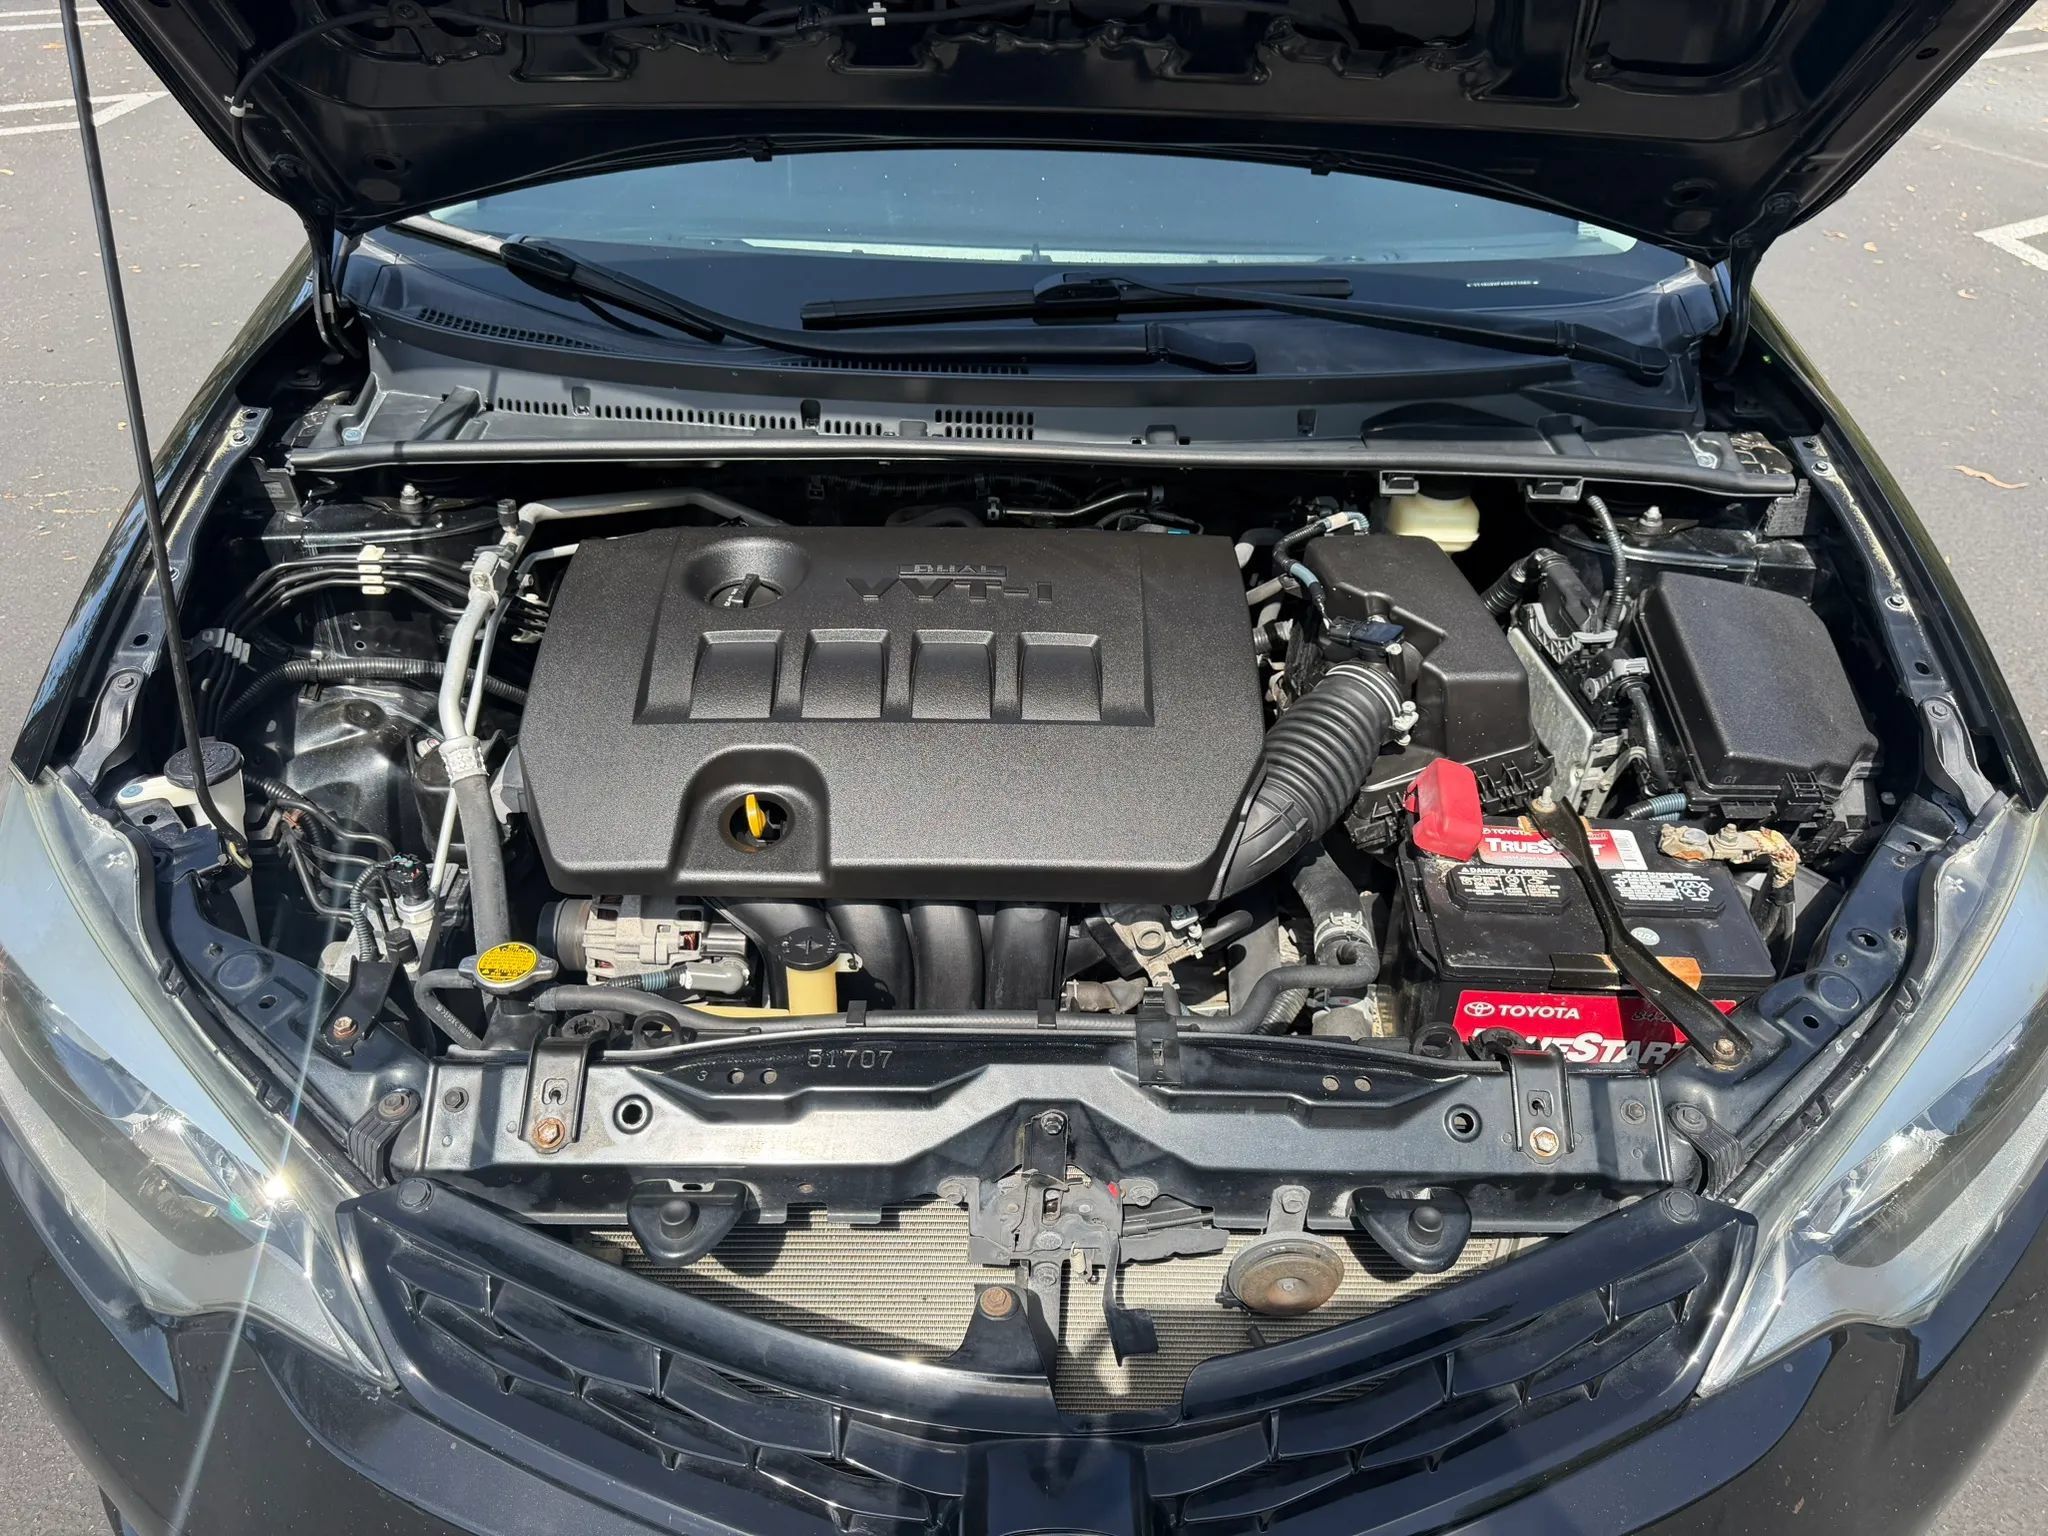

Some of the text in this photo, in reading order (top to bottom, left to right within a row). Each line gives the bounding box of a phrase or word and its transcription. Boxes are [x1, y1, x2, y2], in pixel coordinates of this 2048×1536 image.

[914, 564, 997, 574] DUAL
[1484, 837, 1605, 856] TRUEST
[1469, 867, 1507, 875] DANGER
[1514, 868, 1548, 876] POISON
[1499, 1004, 1580, 1020] TOYOTA
[807, 1049, 893, 1069] 51707
